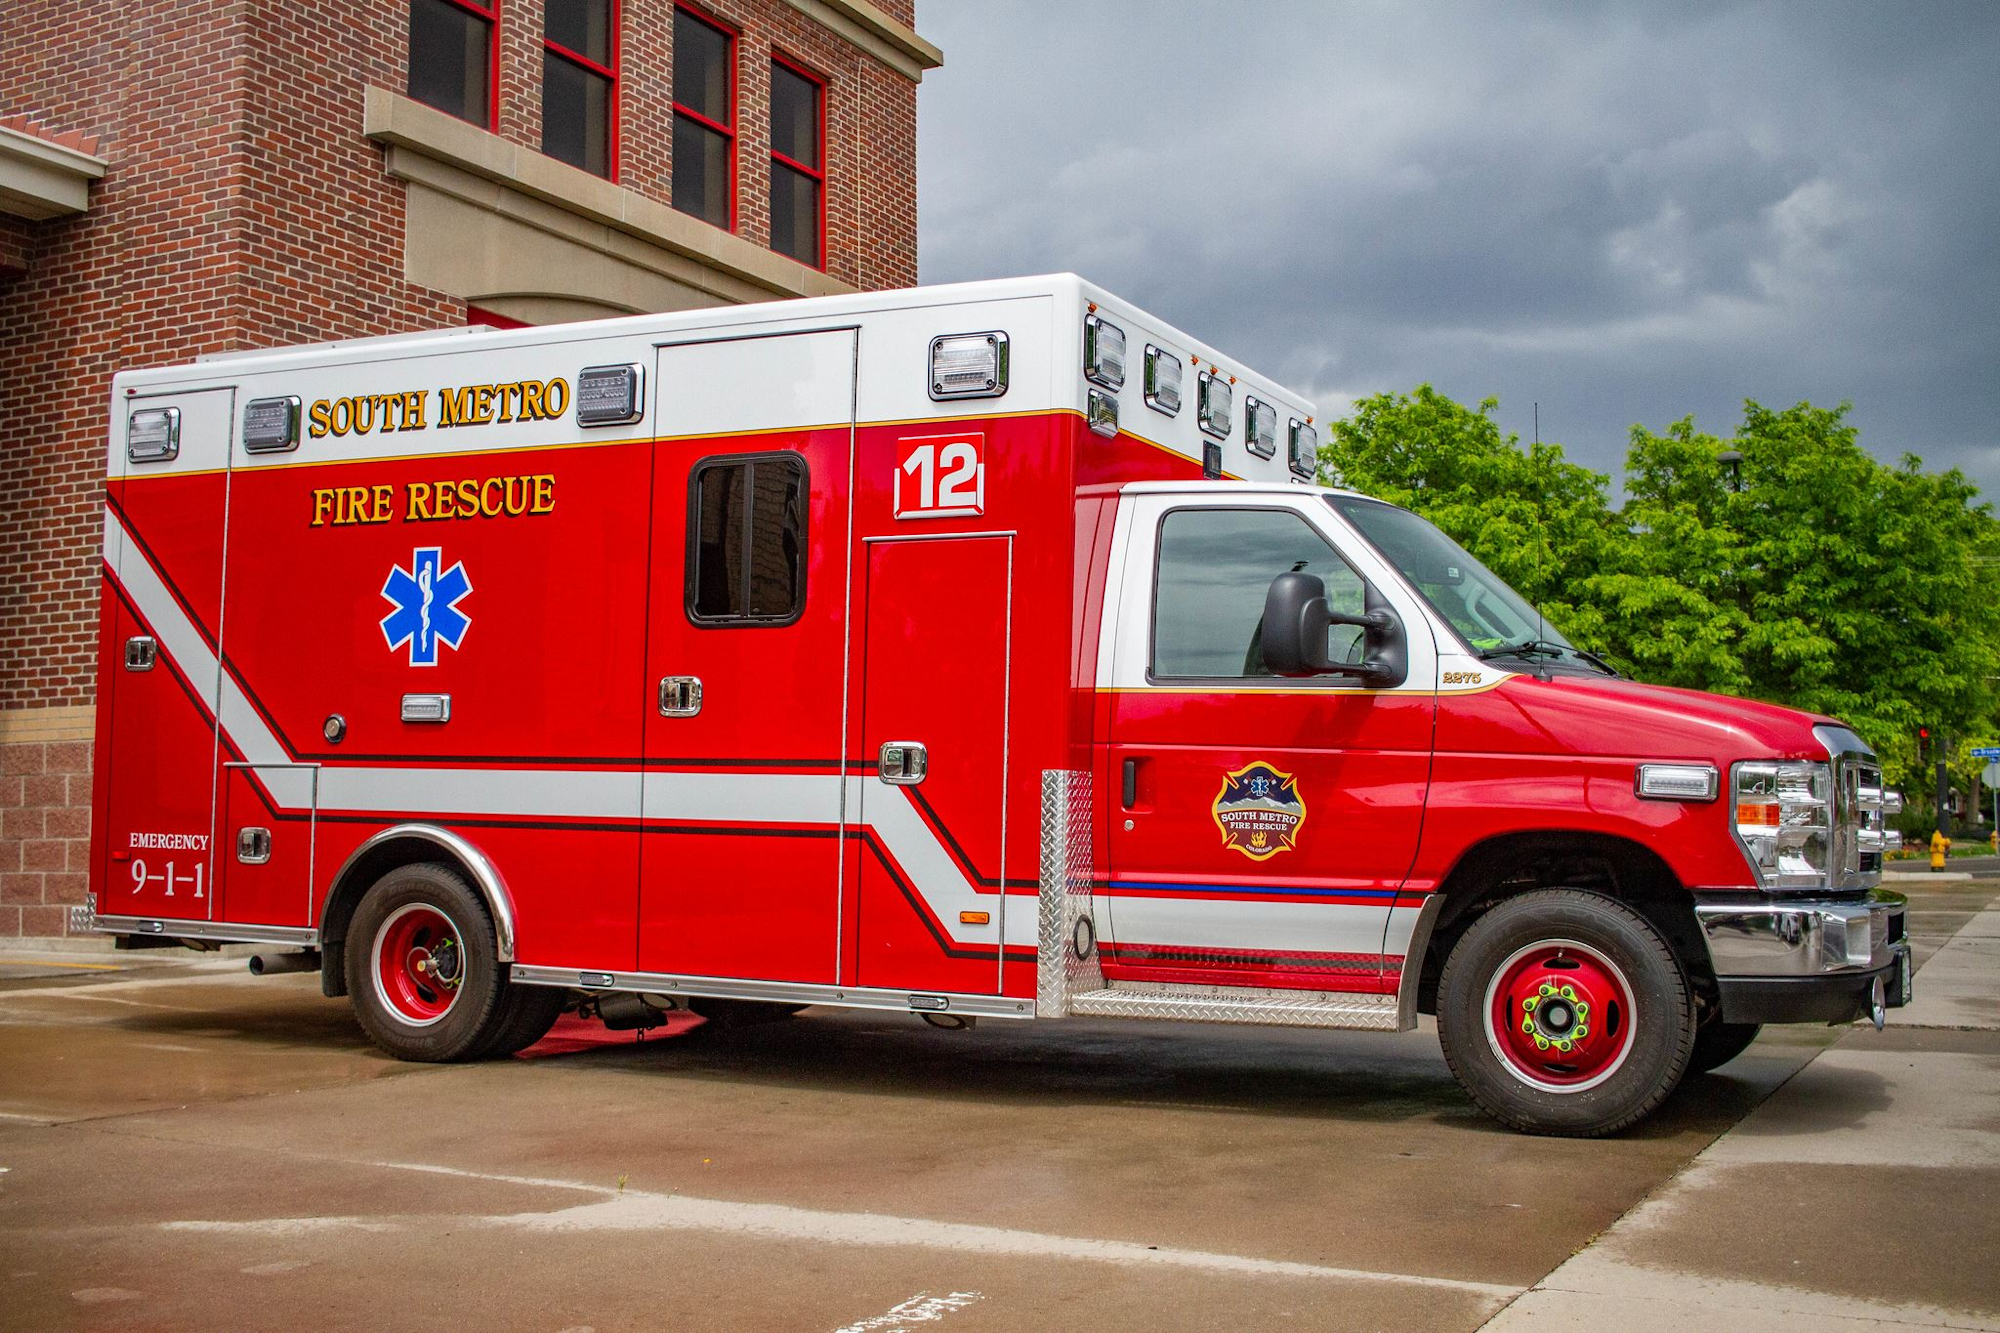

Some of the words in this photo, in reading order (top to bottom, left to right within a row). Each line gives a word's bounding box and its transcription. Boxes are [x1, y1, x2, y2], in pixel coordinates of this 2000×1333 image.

[309, 389, 429, 438] SOUTH
[437, 377, 570, 429] METRO
[902, 442, 978, 508] 12
[309, 484, 395, 528] FIRE
[403, 473, 556, 522] RESCUE
[1442, 671, 1482, 684] 2275
[1221, 812, 1257, 822] SOUTH
[1259, 812, 1297, 824] METRO
[130, 832, 209, 851] EMERGENCY
[131, 858, 204, 898] 9-1-1
